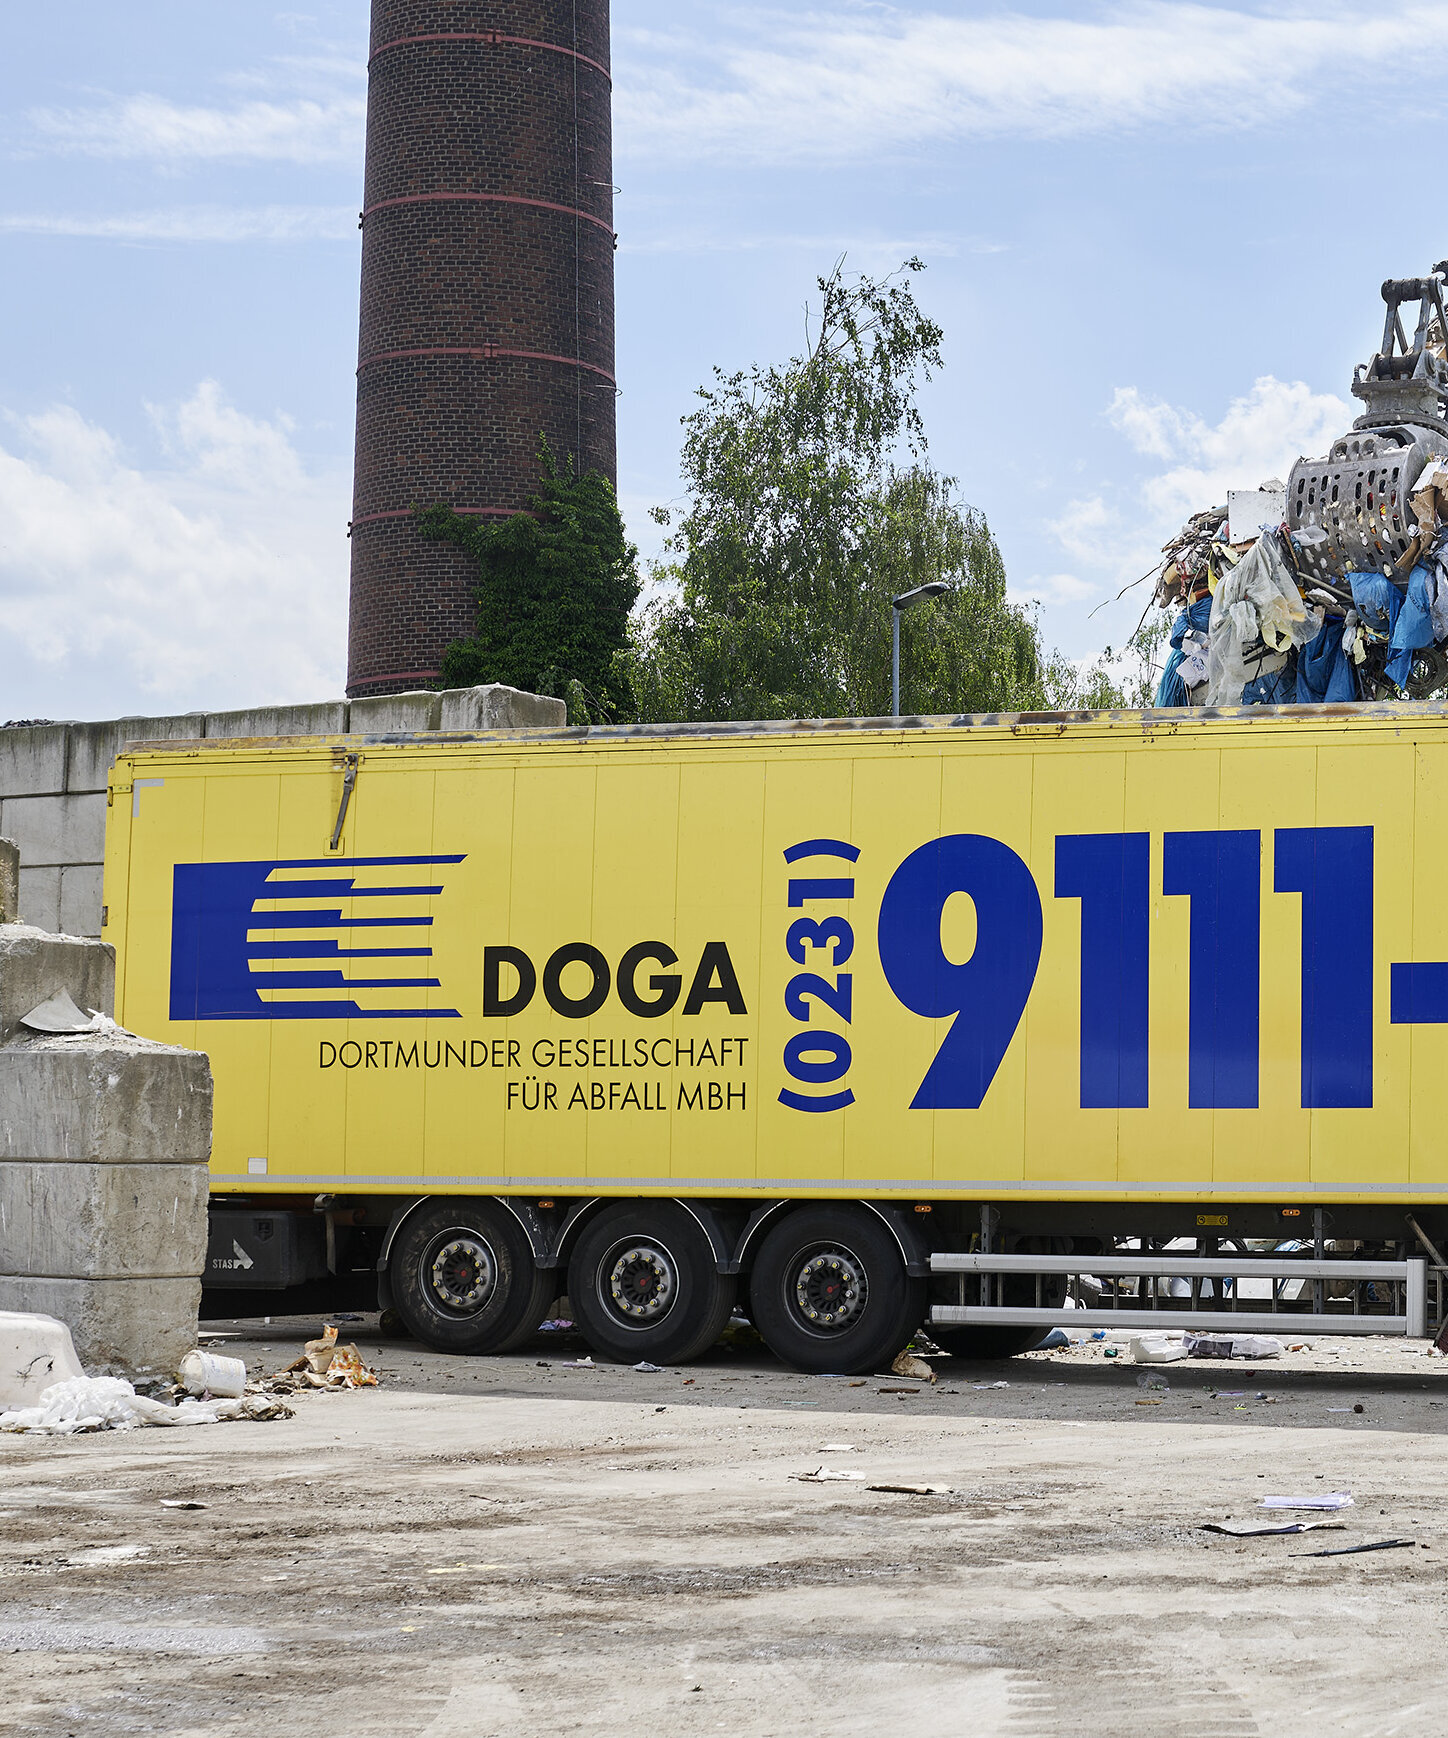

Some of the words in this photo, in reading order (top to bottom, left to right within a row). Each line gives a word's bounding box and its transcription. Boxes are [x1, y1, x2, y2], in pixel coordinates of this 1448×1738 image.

[483, 941, 748, 1018] DOGA
[777, 838, 862, 1113] (0231)
[319, 1039, 522, 1069] DORTMUNDER
[531, 1037, 750, 1068] GESELLSCHAFT
[507, 1075, 558, 1111] FÜR
[567, 1081, 667, 1111] ABFALL
[676, 1081, 747, 1111] MBH
[212, 1259, 233, 1270] STAS
